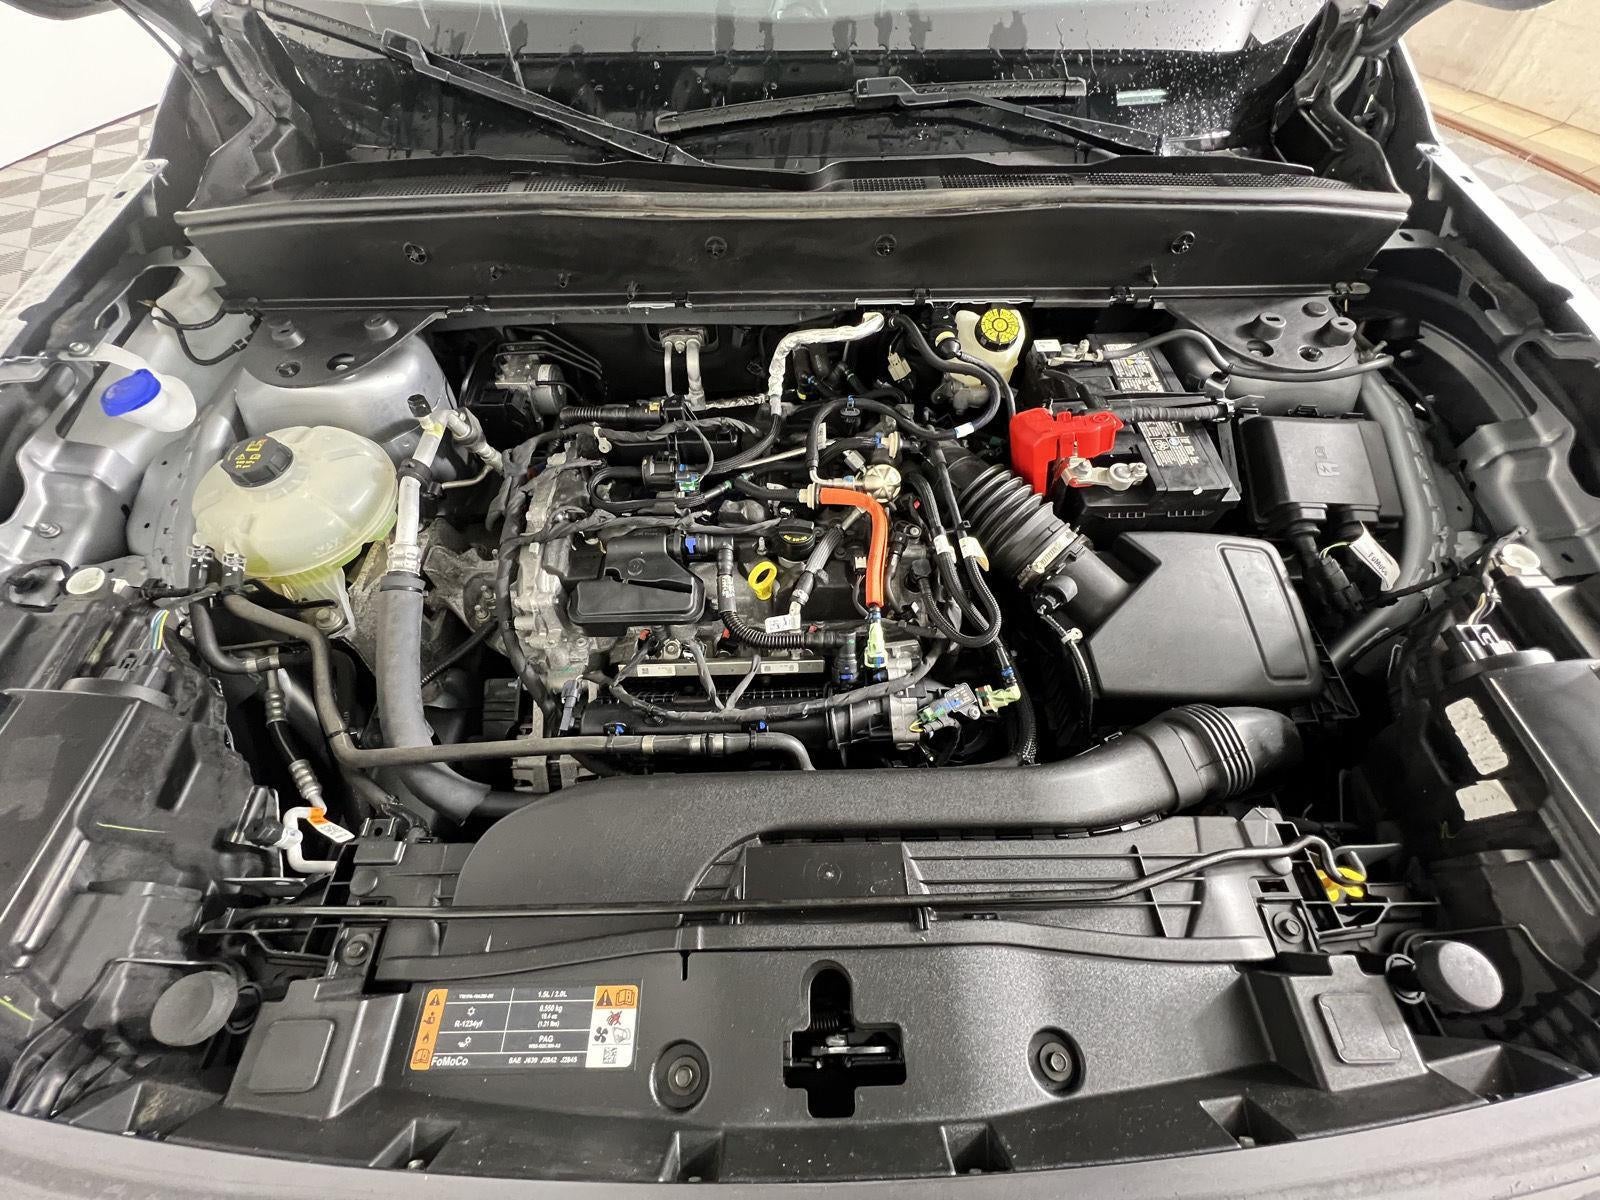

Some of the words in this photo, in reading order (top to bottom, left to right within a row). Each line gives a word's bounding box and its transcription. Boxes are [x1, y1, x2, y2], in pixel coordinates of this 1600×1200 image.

[454, 1020, 483, 1029] R-1234yf
[538, 1035, 554, 1043] PAG
[431, 1056, 469, 1066] FoMoCo
